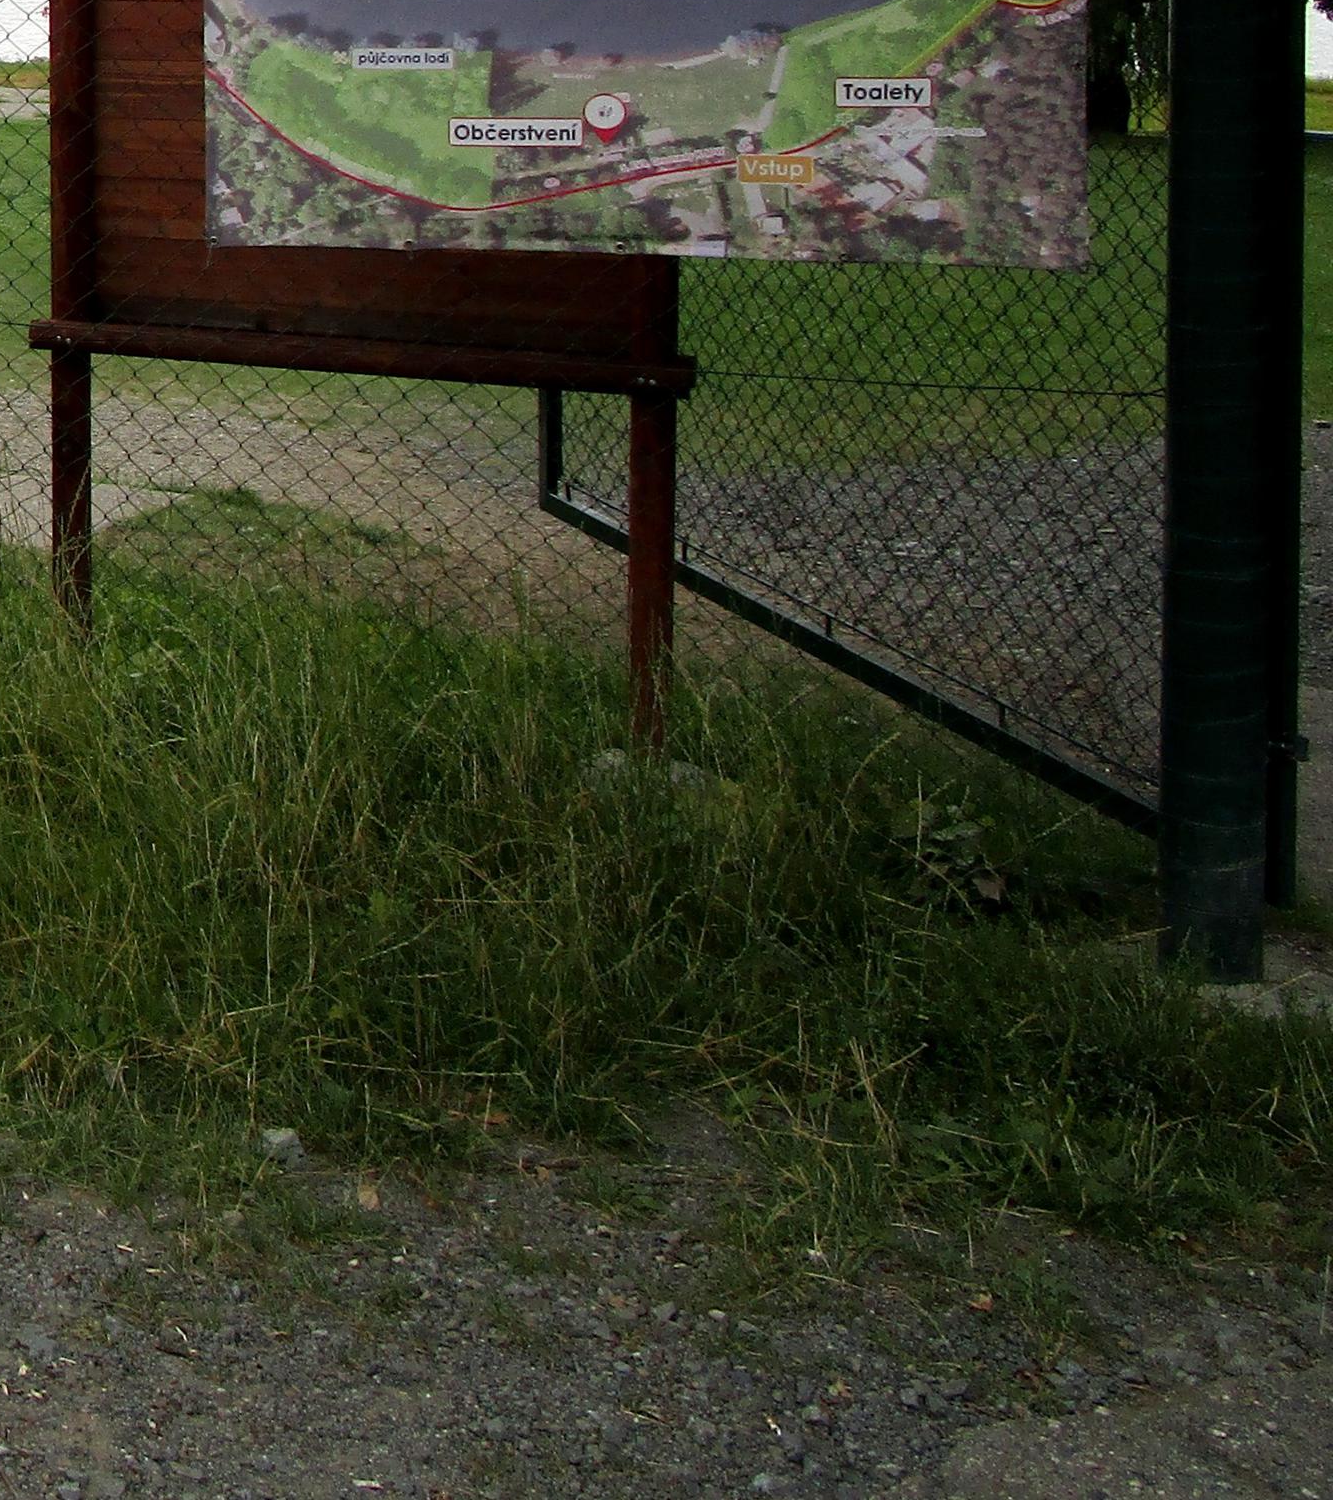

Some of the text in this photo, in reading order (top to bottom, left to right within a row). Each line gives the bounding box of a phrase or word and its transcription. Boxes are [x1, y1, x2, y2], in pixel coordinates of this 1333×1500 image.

[358, 51, 450, 66] půjčovna lodí
[842, 83, 924, 103] Toalety
[454, 122, 578, 142] Občerstvení
[744, 159, 805, 181] Vstup
